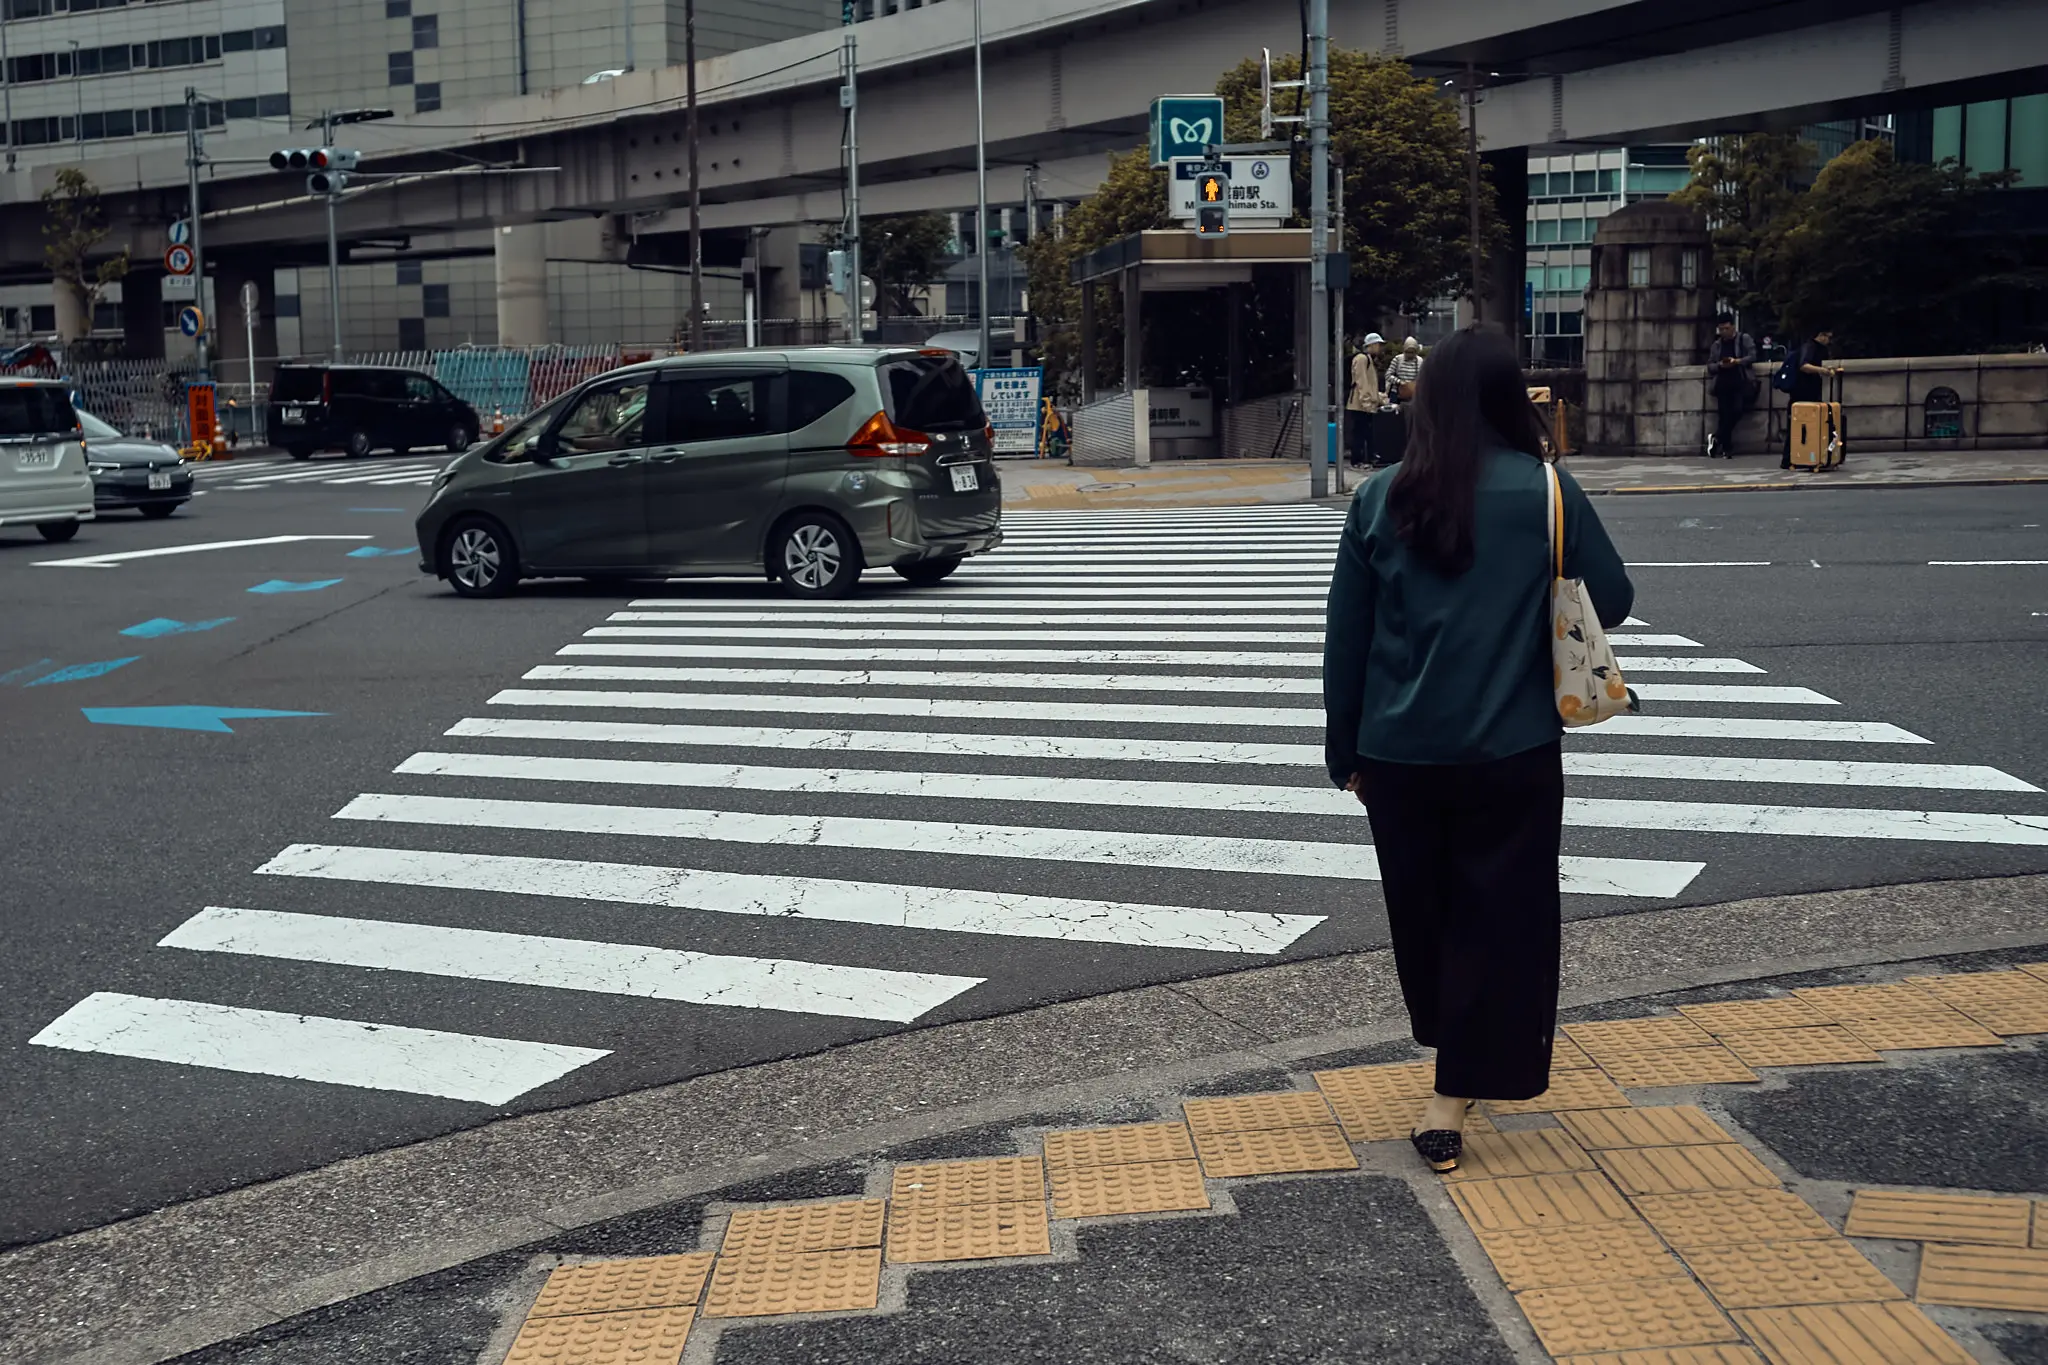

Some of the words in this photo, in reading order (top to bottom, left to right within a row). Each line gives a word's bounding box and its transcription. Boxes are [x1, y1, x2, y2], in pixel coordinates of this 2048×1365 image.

[1185, 163, 1223, 172] 東京メロ
[1260, 200, 1279, 209] Sta.
